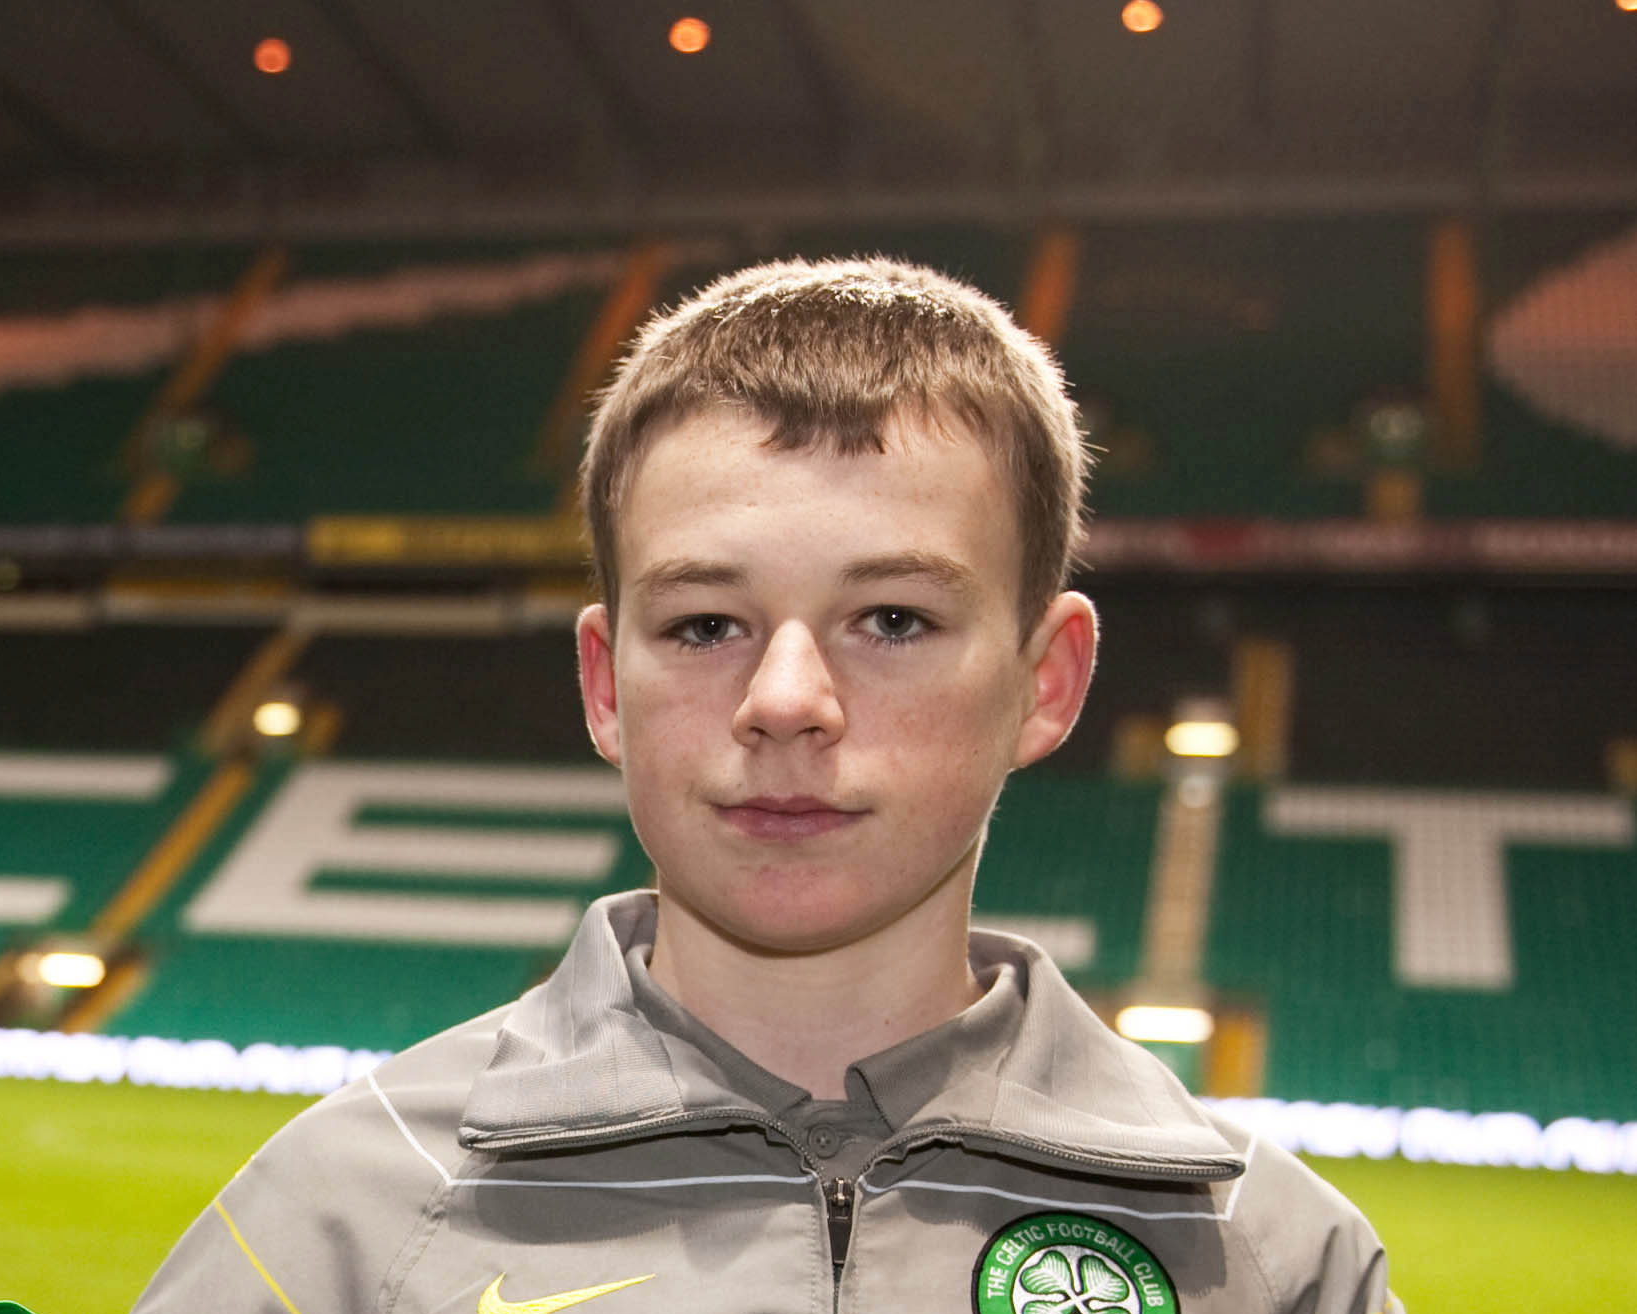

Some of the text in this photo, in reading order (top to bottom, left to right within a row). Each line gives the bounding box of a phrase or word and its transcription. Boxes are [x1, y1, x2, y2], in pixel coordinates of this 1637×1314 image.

[986, 1222, 1165, 1308] THE CELTIC FOOTBALL CLUB
